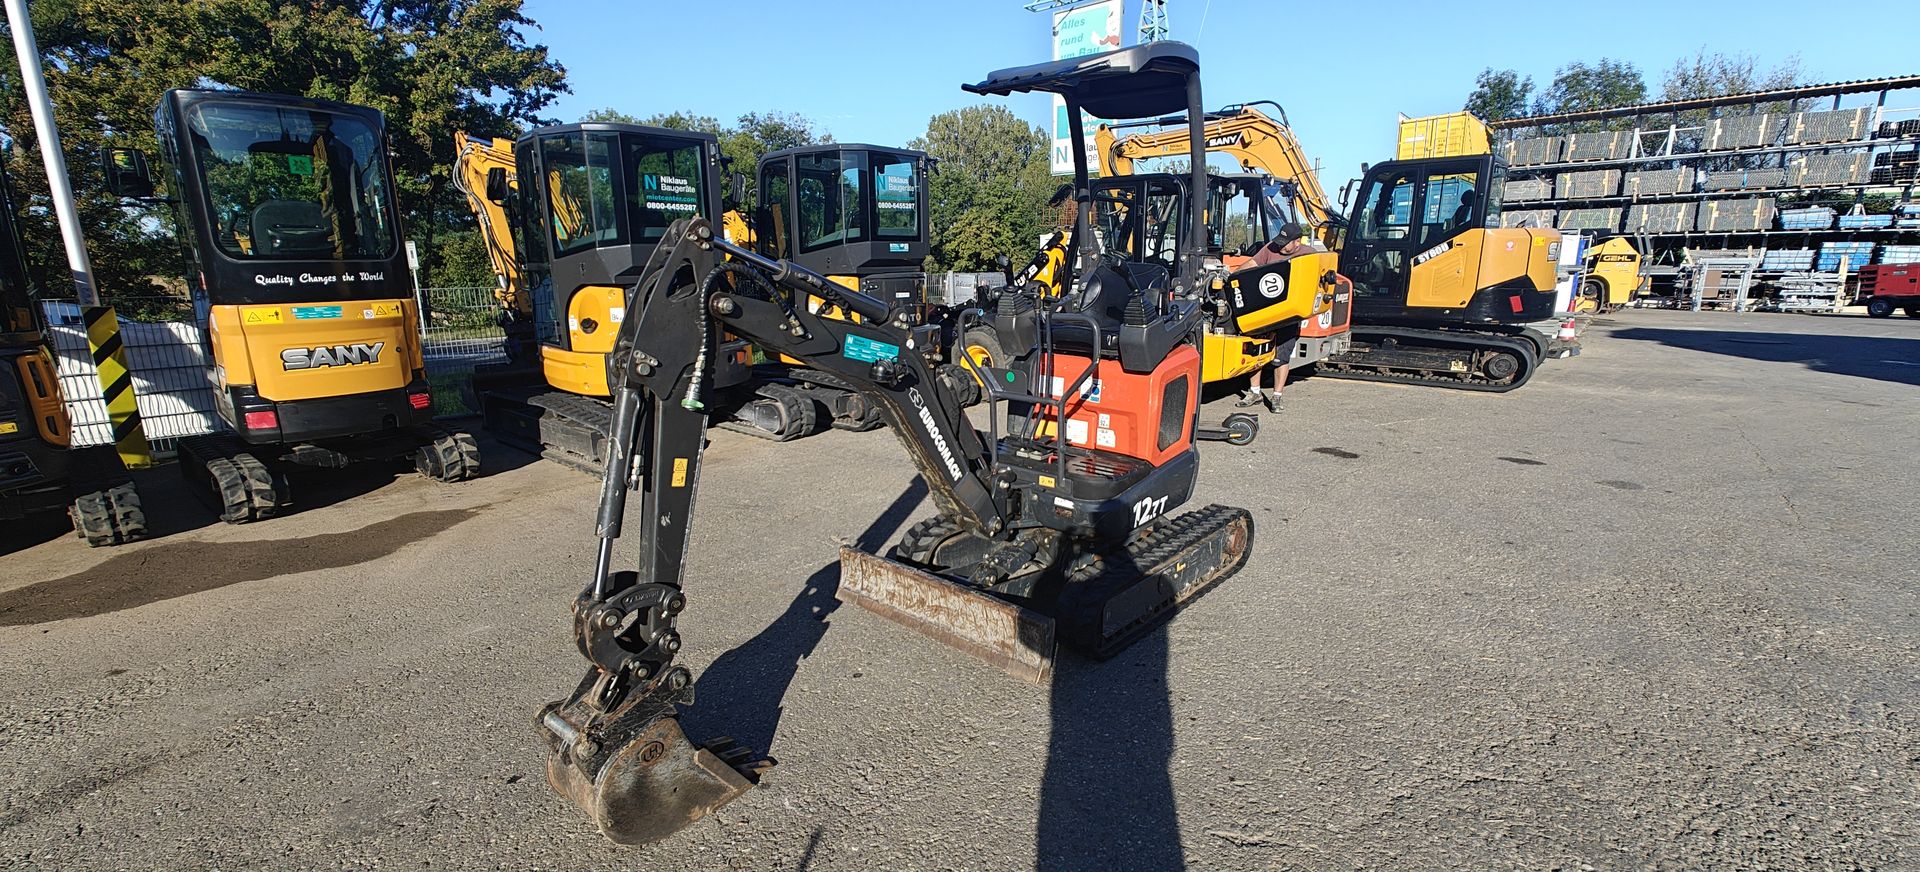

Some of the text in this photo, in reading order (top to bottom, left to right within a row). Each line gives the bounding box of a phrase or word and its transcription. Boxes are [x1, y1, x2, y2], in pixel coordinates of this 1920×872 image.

[1061, 18, 1086, 31] Alles
[1060, 33, 1084, 46] rund
[1209, 134, 1237, 147] SANY
[644, 174, 657, 190] N
[660, 175, 688, 185] Niklaus
[660, 183, 696, 193] Baugeräte
[646, 201, 697, 211] 0800-6455287
[1602, 254, 1632, 262] GEHL
[254, 271, 384, 286] Quality Changes the World
[1264, 277, 1279, 294] 20
[281, 341, 385, 371] SANY
[919, 405, 963, 482] EUROCOMACH
